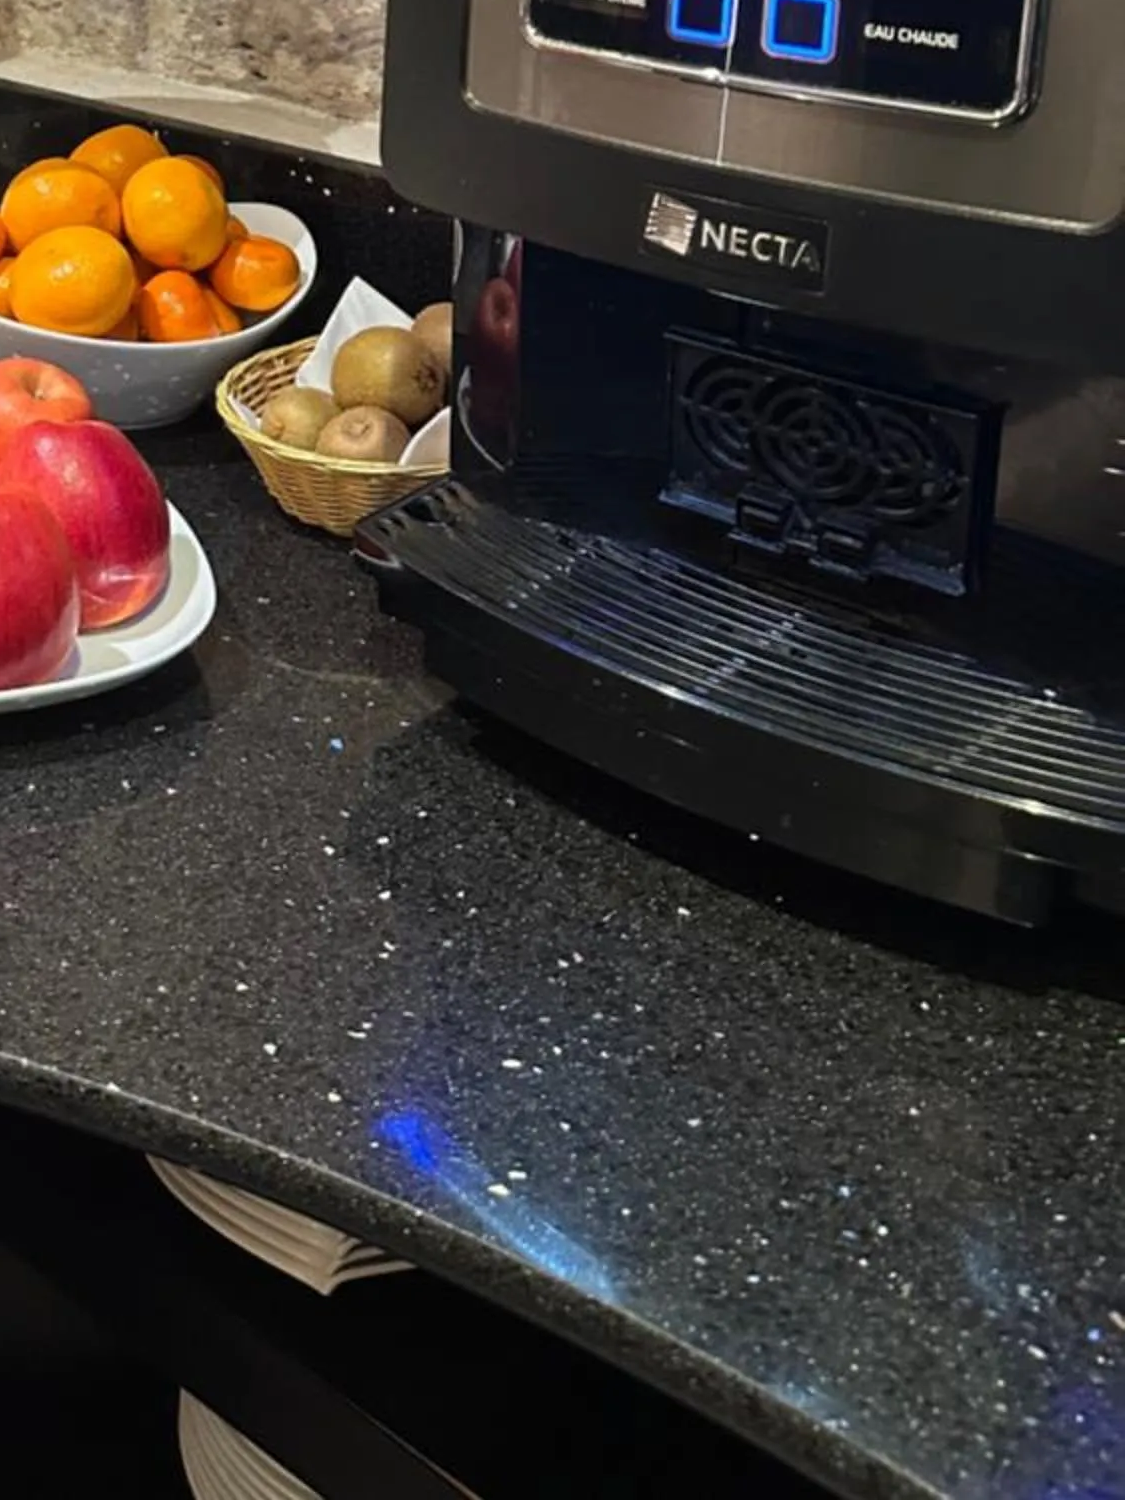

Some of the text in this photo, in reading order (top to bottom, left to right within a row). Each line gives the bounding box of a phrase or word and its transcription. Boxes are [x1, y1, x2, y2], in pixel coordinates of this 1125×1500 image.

[864, 22, 960, 51] EAU CHAUDE
[700, 218, 821, 272] NECTA
